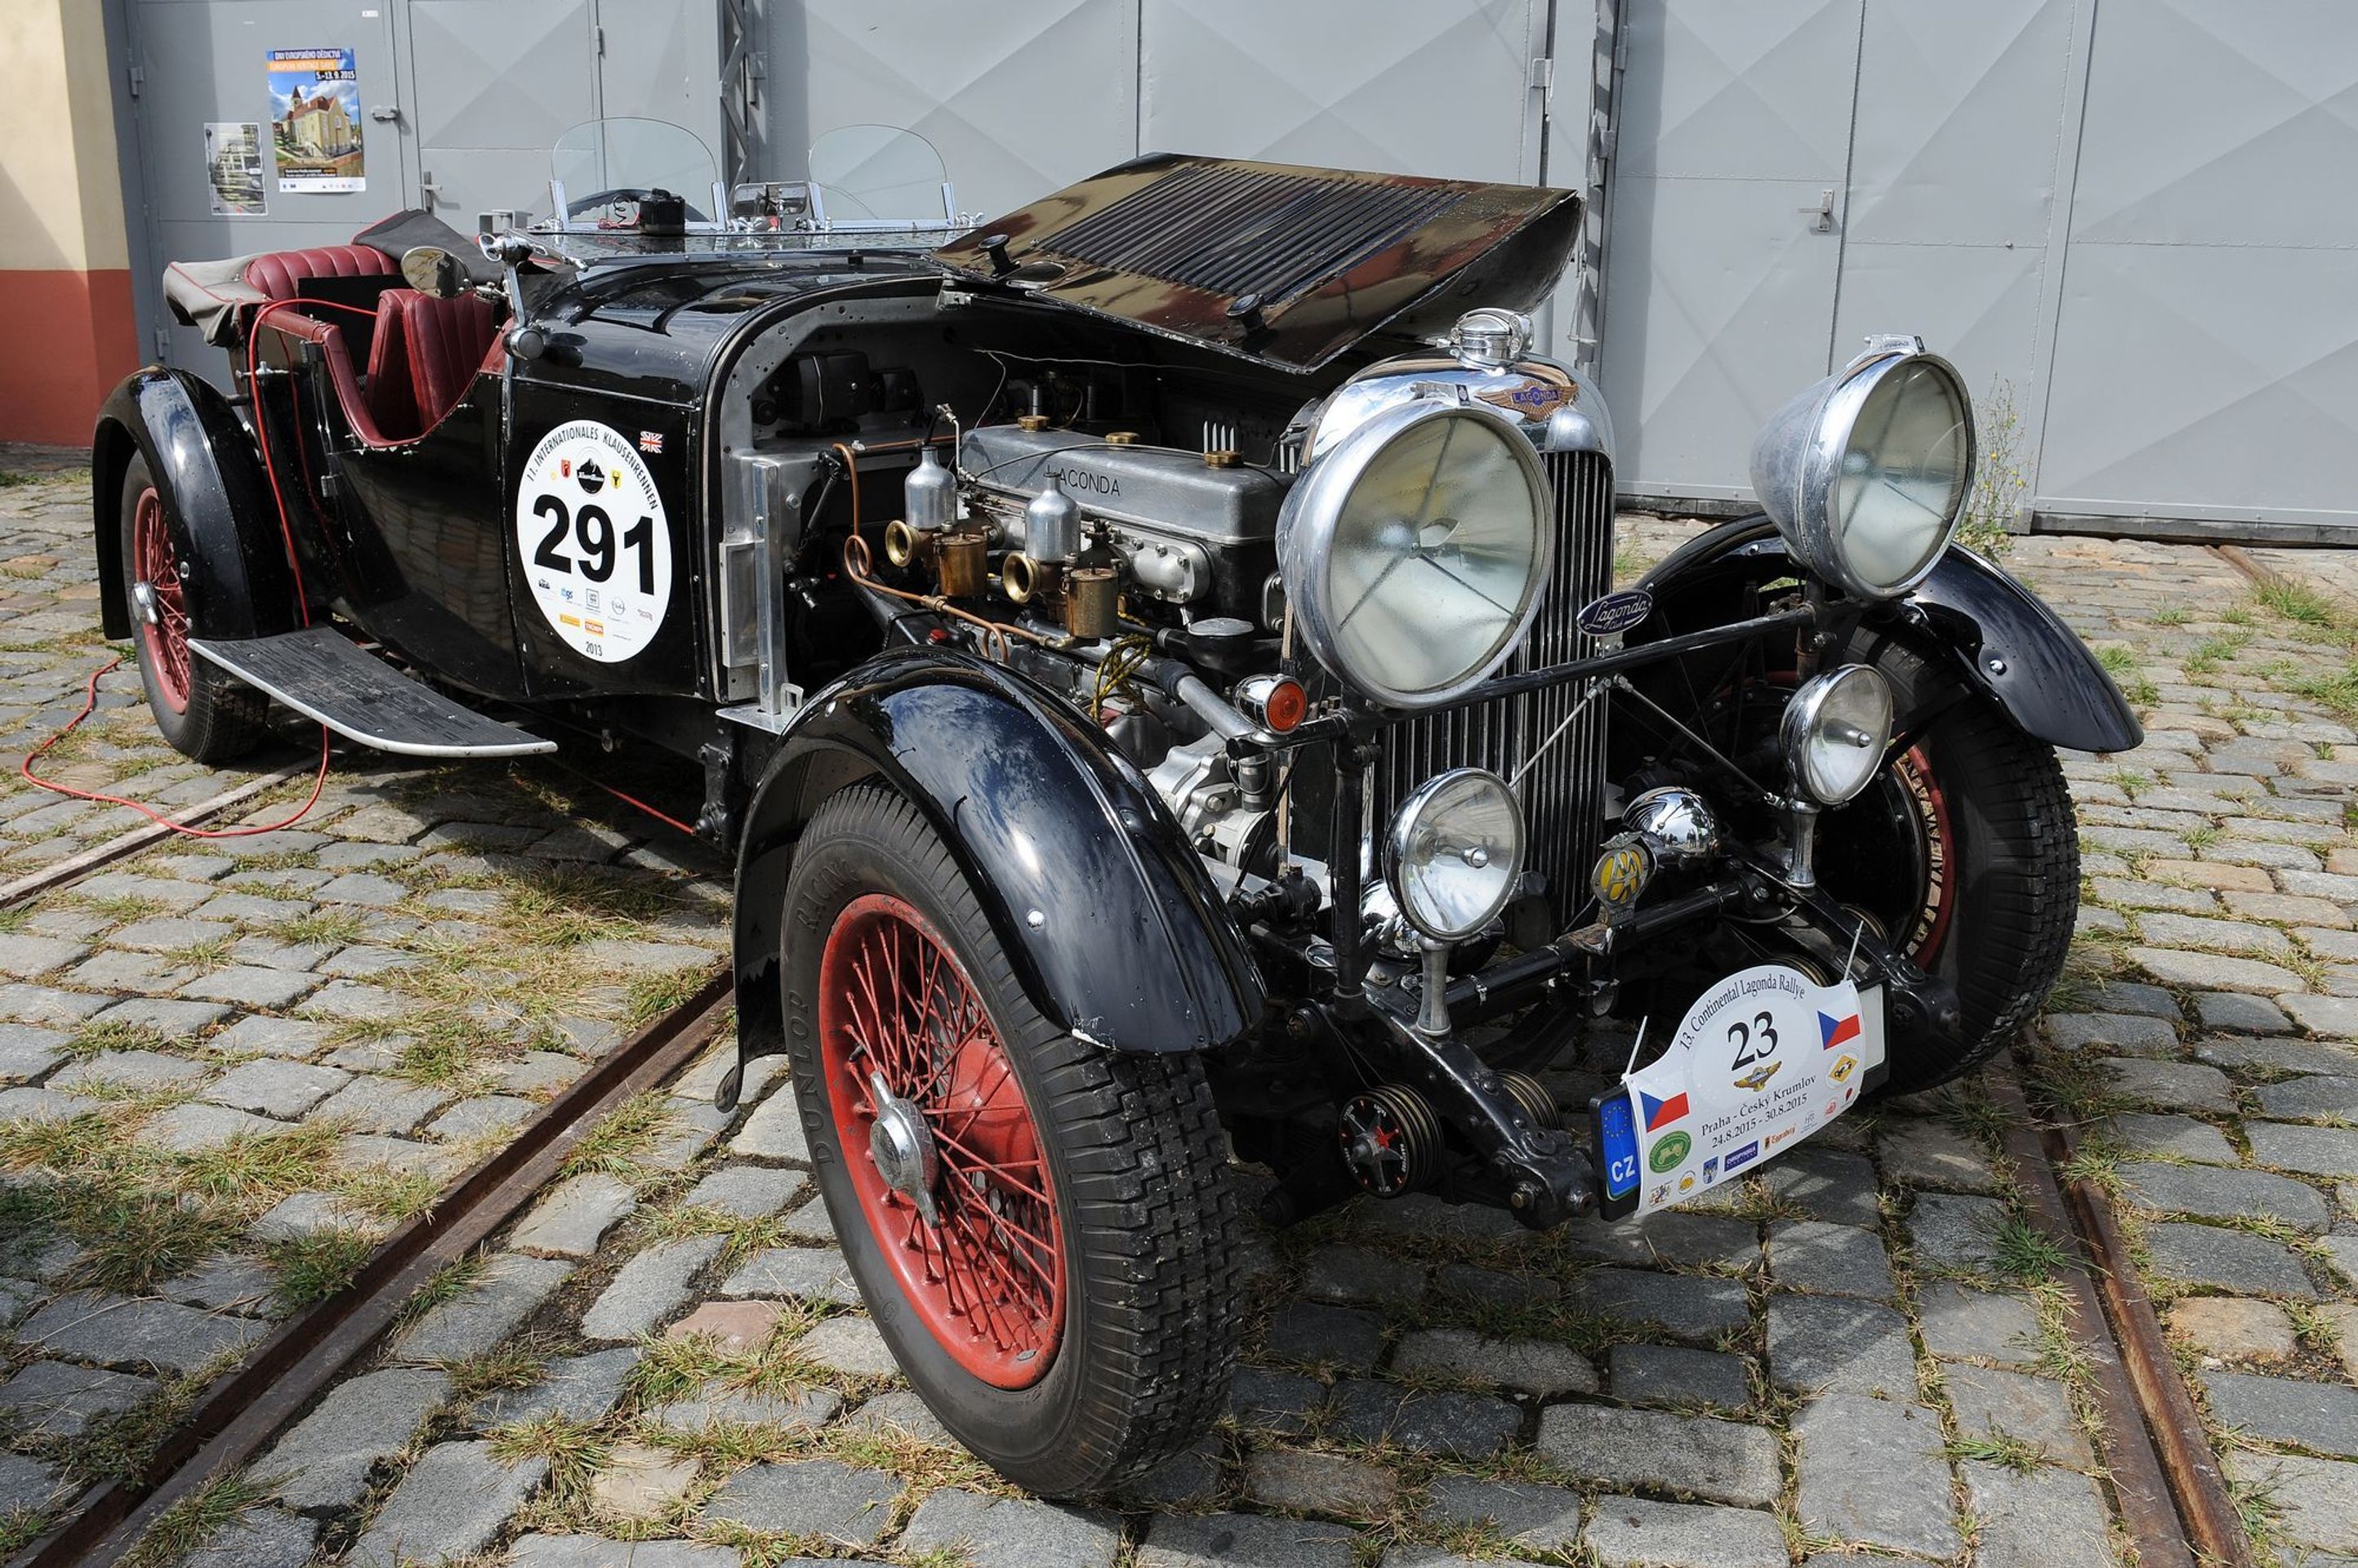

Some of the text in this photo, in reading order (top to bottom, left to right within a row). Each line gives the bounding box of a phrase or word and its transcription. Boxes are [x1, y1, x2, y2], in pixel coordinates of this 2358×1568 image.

[340, 71, 354, 79] 2015
[1513, 390, 1558, 402] LAGONDA
[527, 425, 658, 510] 11. INTERNATIONALES KLAUSENRENNEN
[533, 494, 655, 596] 291
[1585, 594, 1648, 630] Lagonda
[586, 640, 604, 657] 2013
[1680, 973, 1805, 1052] 13. Continental Lagonda Rallye
[1727, 1011, 1778, 1071] 23
[788, 989, 836, 1166] DUNLOP
[1701, 1117, 1731, 1136] Praha
[1740, 1094, 1770, 1117] Český
[1773, 1075, 1816, 1102] Krumlov
[1712, 1117, 1756, 1148] 24.8.2015
[1765, 1093, 1808, 1122] 30.8.2015
[1611, 1155, 1635, 1183] CZ
